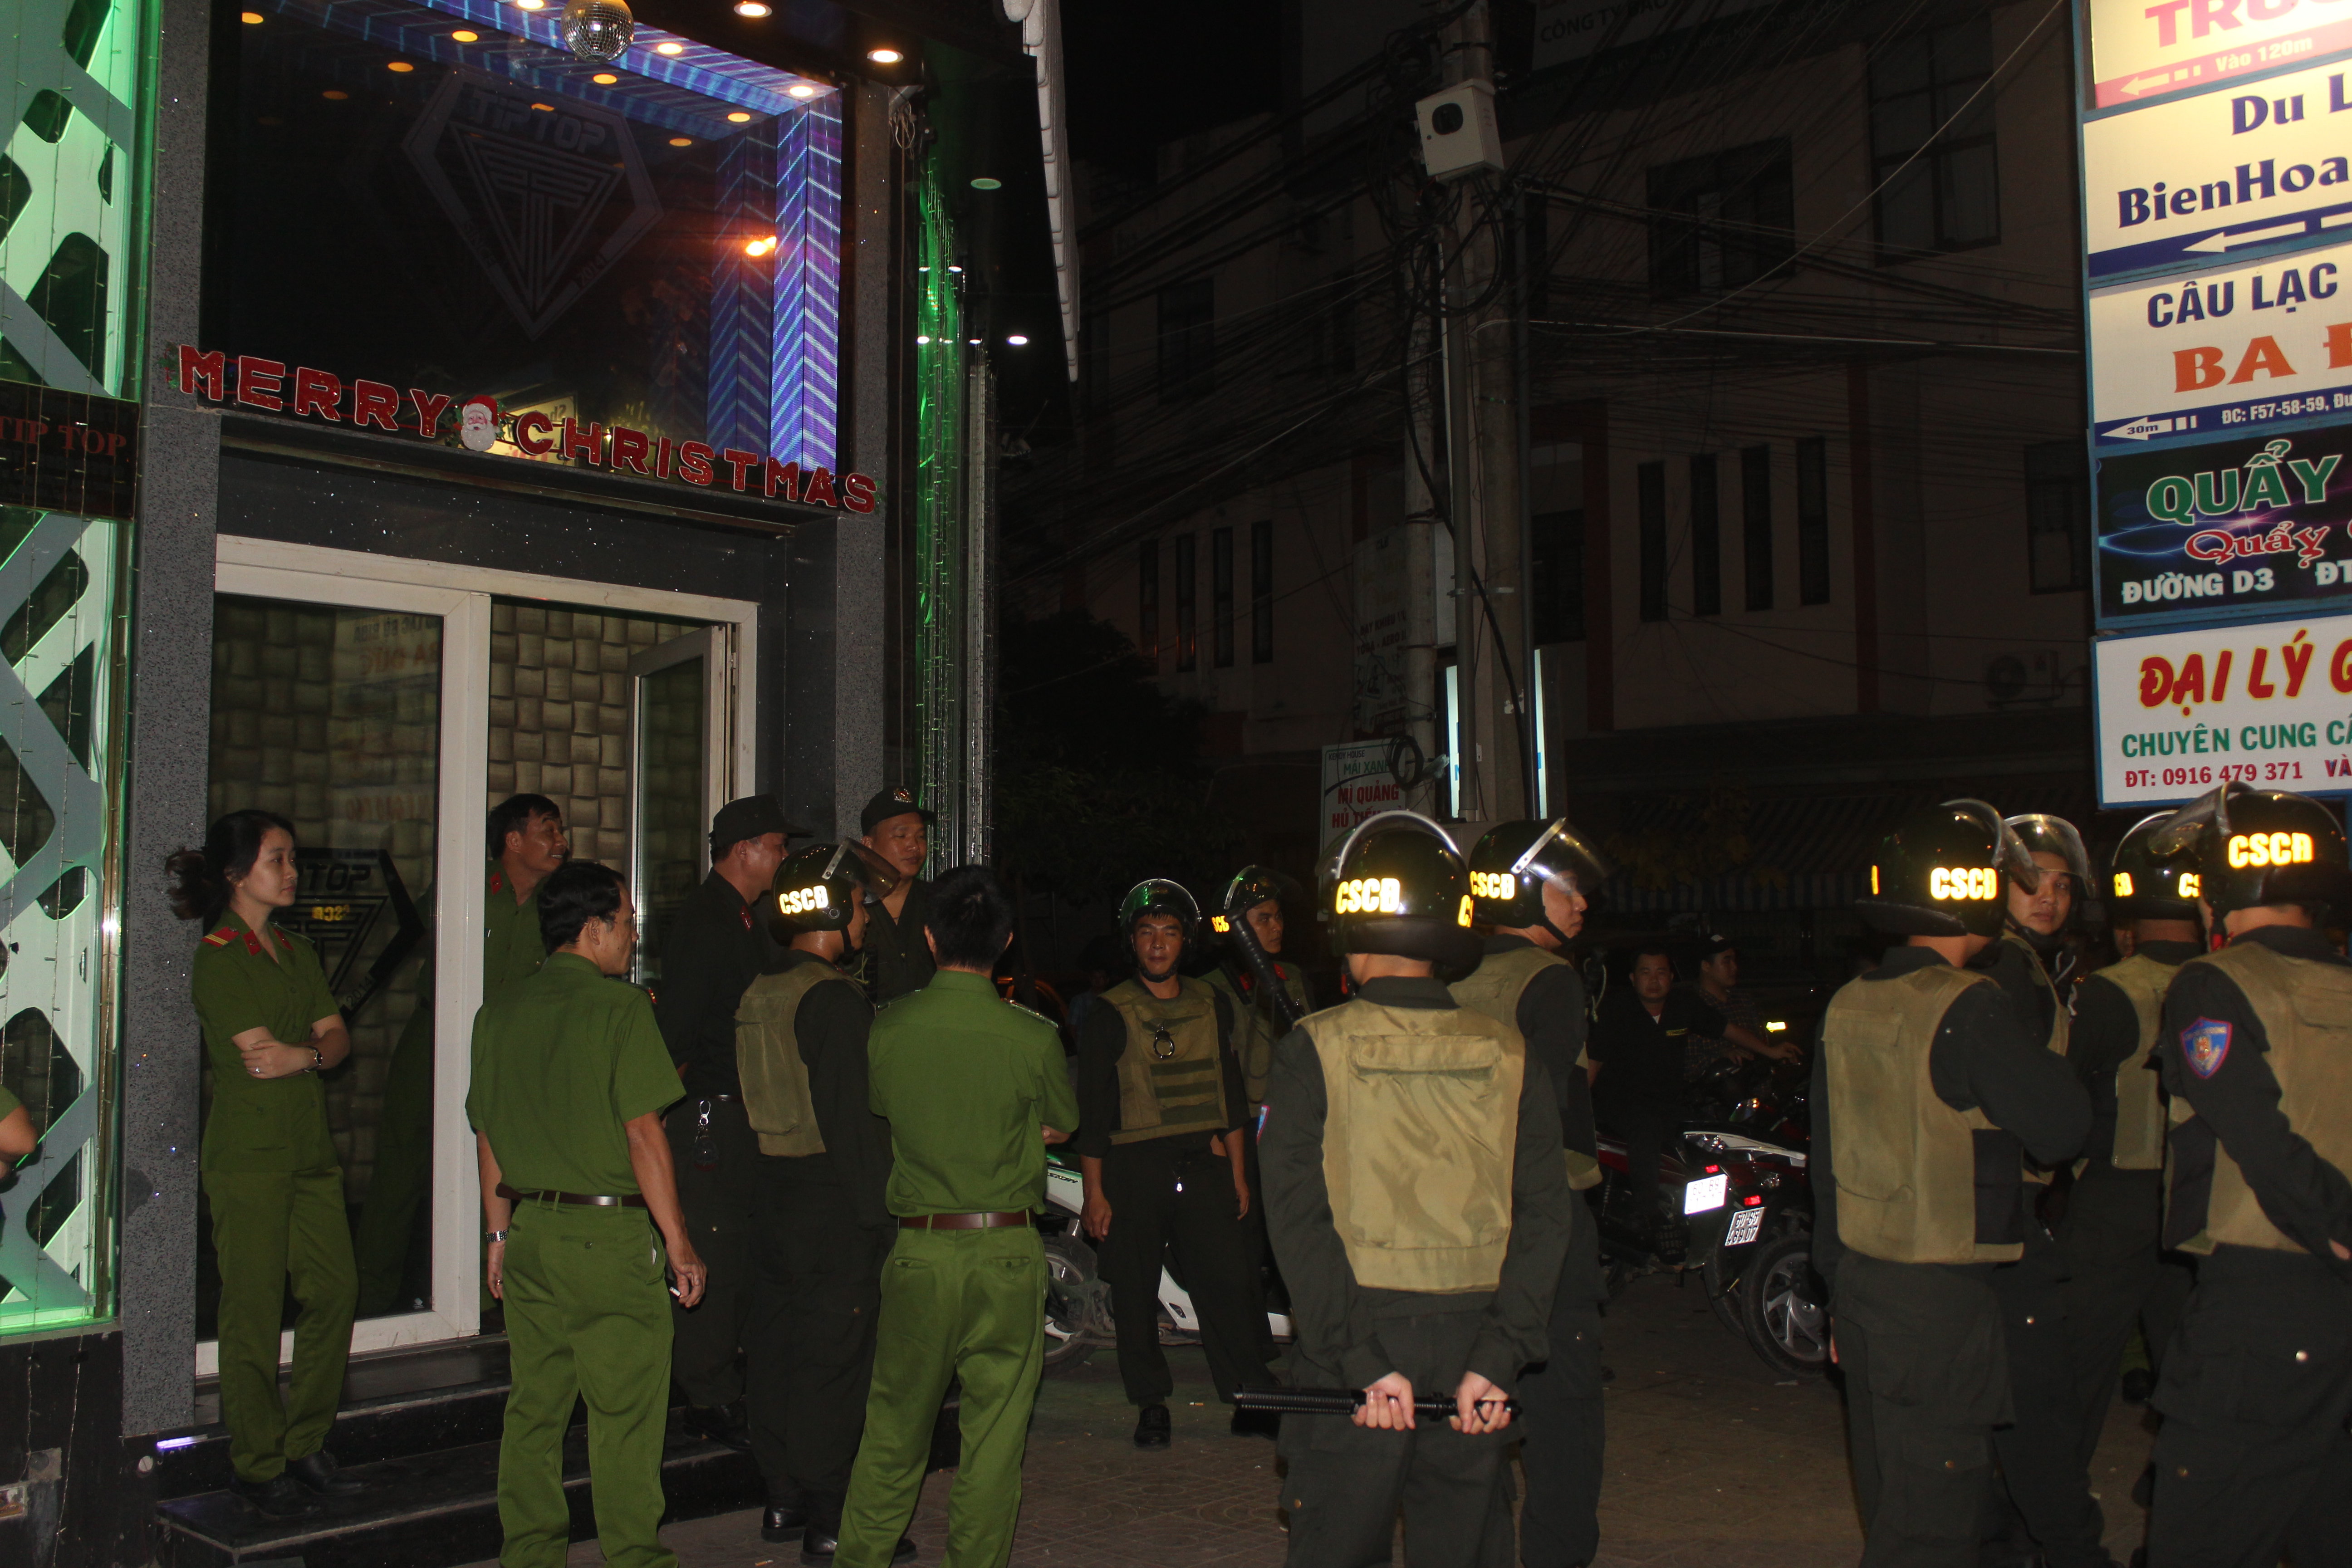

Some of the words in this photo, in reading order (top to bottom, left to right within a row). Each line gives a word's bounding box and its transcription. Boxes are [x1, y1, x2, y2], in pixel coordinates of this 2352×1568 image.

[2215, 53, 2251, 72] Vào
[2257, 37, 2313, 62] 120m
[2231, 93, 2305, 136] Du
[2117, 156, 2350, 229] BienHoa
[2147, 280, 2234, 328] CÂU
[2251, 262, 2338, 314] LẠC
[2173, 334, 2298, 393] BA
[2222, 409, 2246, 425] ĐC:
[2250, 395, 2329, 420] F57-58-59,
[58, 425, 127, 456] TOP
[179, 344, 451, 438] MERRY
[516, 411, 878, 514] CHRISTMAS
[2127, 424, 2158, 435] 30m
[2146, 439, 2342, 526] QUẨY
[2185, 520, 2331, 569] Quẩy
[2122, 570, 2224, 604] ĐƯỜNG
[2232, 568, 2274, 594] D3
[2139, 648, 2234, 718] ĐẠI
[2246, 628, 2315, 700] LÝ
[1347, 750, 1365, 759] HOUSE
[2122, 724, 2230, 758] CHUYÊN
[2239, 722, 2317, 751] CUNG
[1343, 759, 1361, 775] MÁI
[2125, 769, 2157, 789] ĐT:
[2162, 766, 2212, 786] 0916
[2219, 763, 2258, 784] 479
[2264, 761, 2303, 780] 371
[1357, 779, 1399, 803] QUẢNG
[1332, 807, 1349, 828] HỦ
[305, 862, 371, 892] TOP
[346, 976, 373, 1009] 2014
